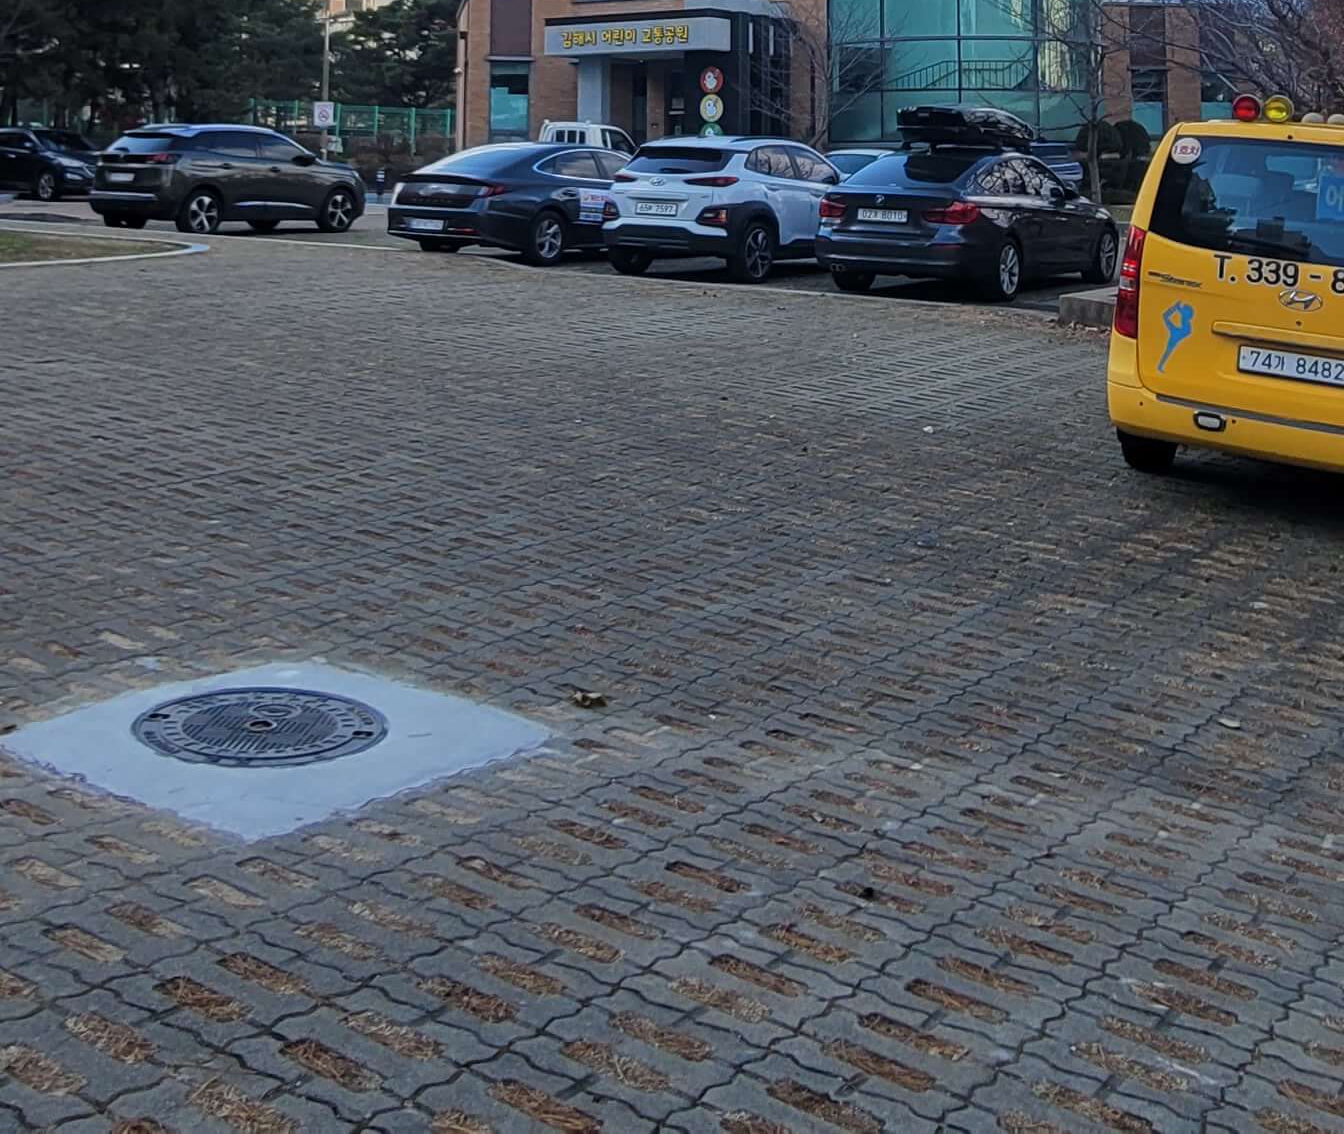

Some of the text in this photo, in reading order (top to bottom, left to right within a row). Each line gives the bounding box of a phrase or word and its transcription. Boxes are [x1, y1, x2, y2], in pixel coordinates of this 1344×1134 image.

[561, 25, 689, 49] 김해시 어린이 교통공원
[1213, 254, 1238, 283] T.
[1246, 257, 1300, 288] 339
